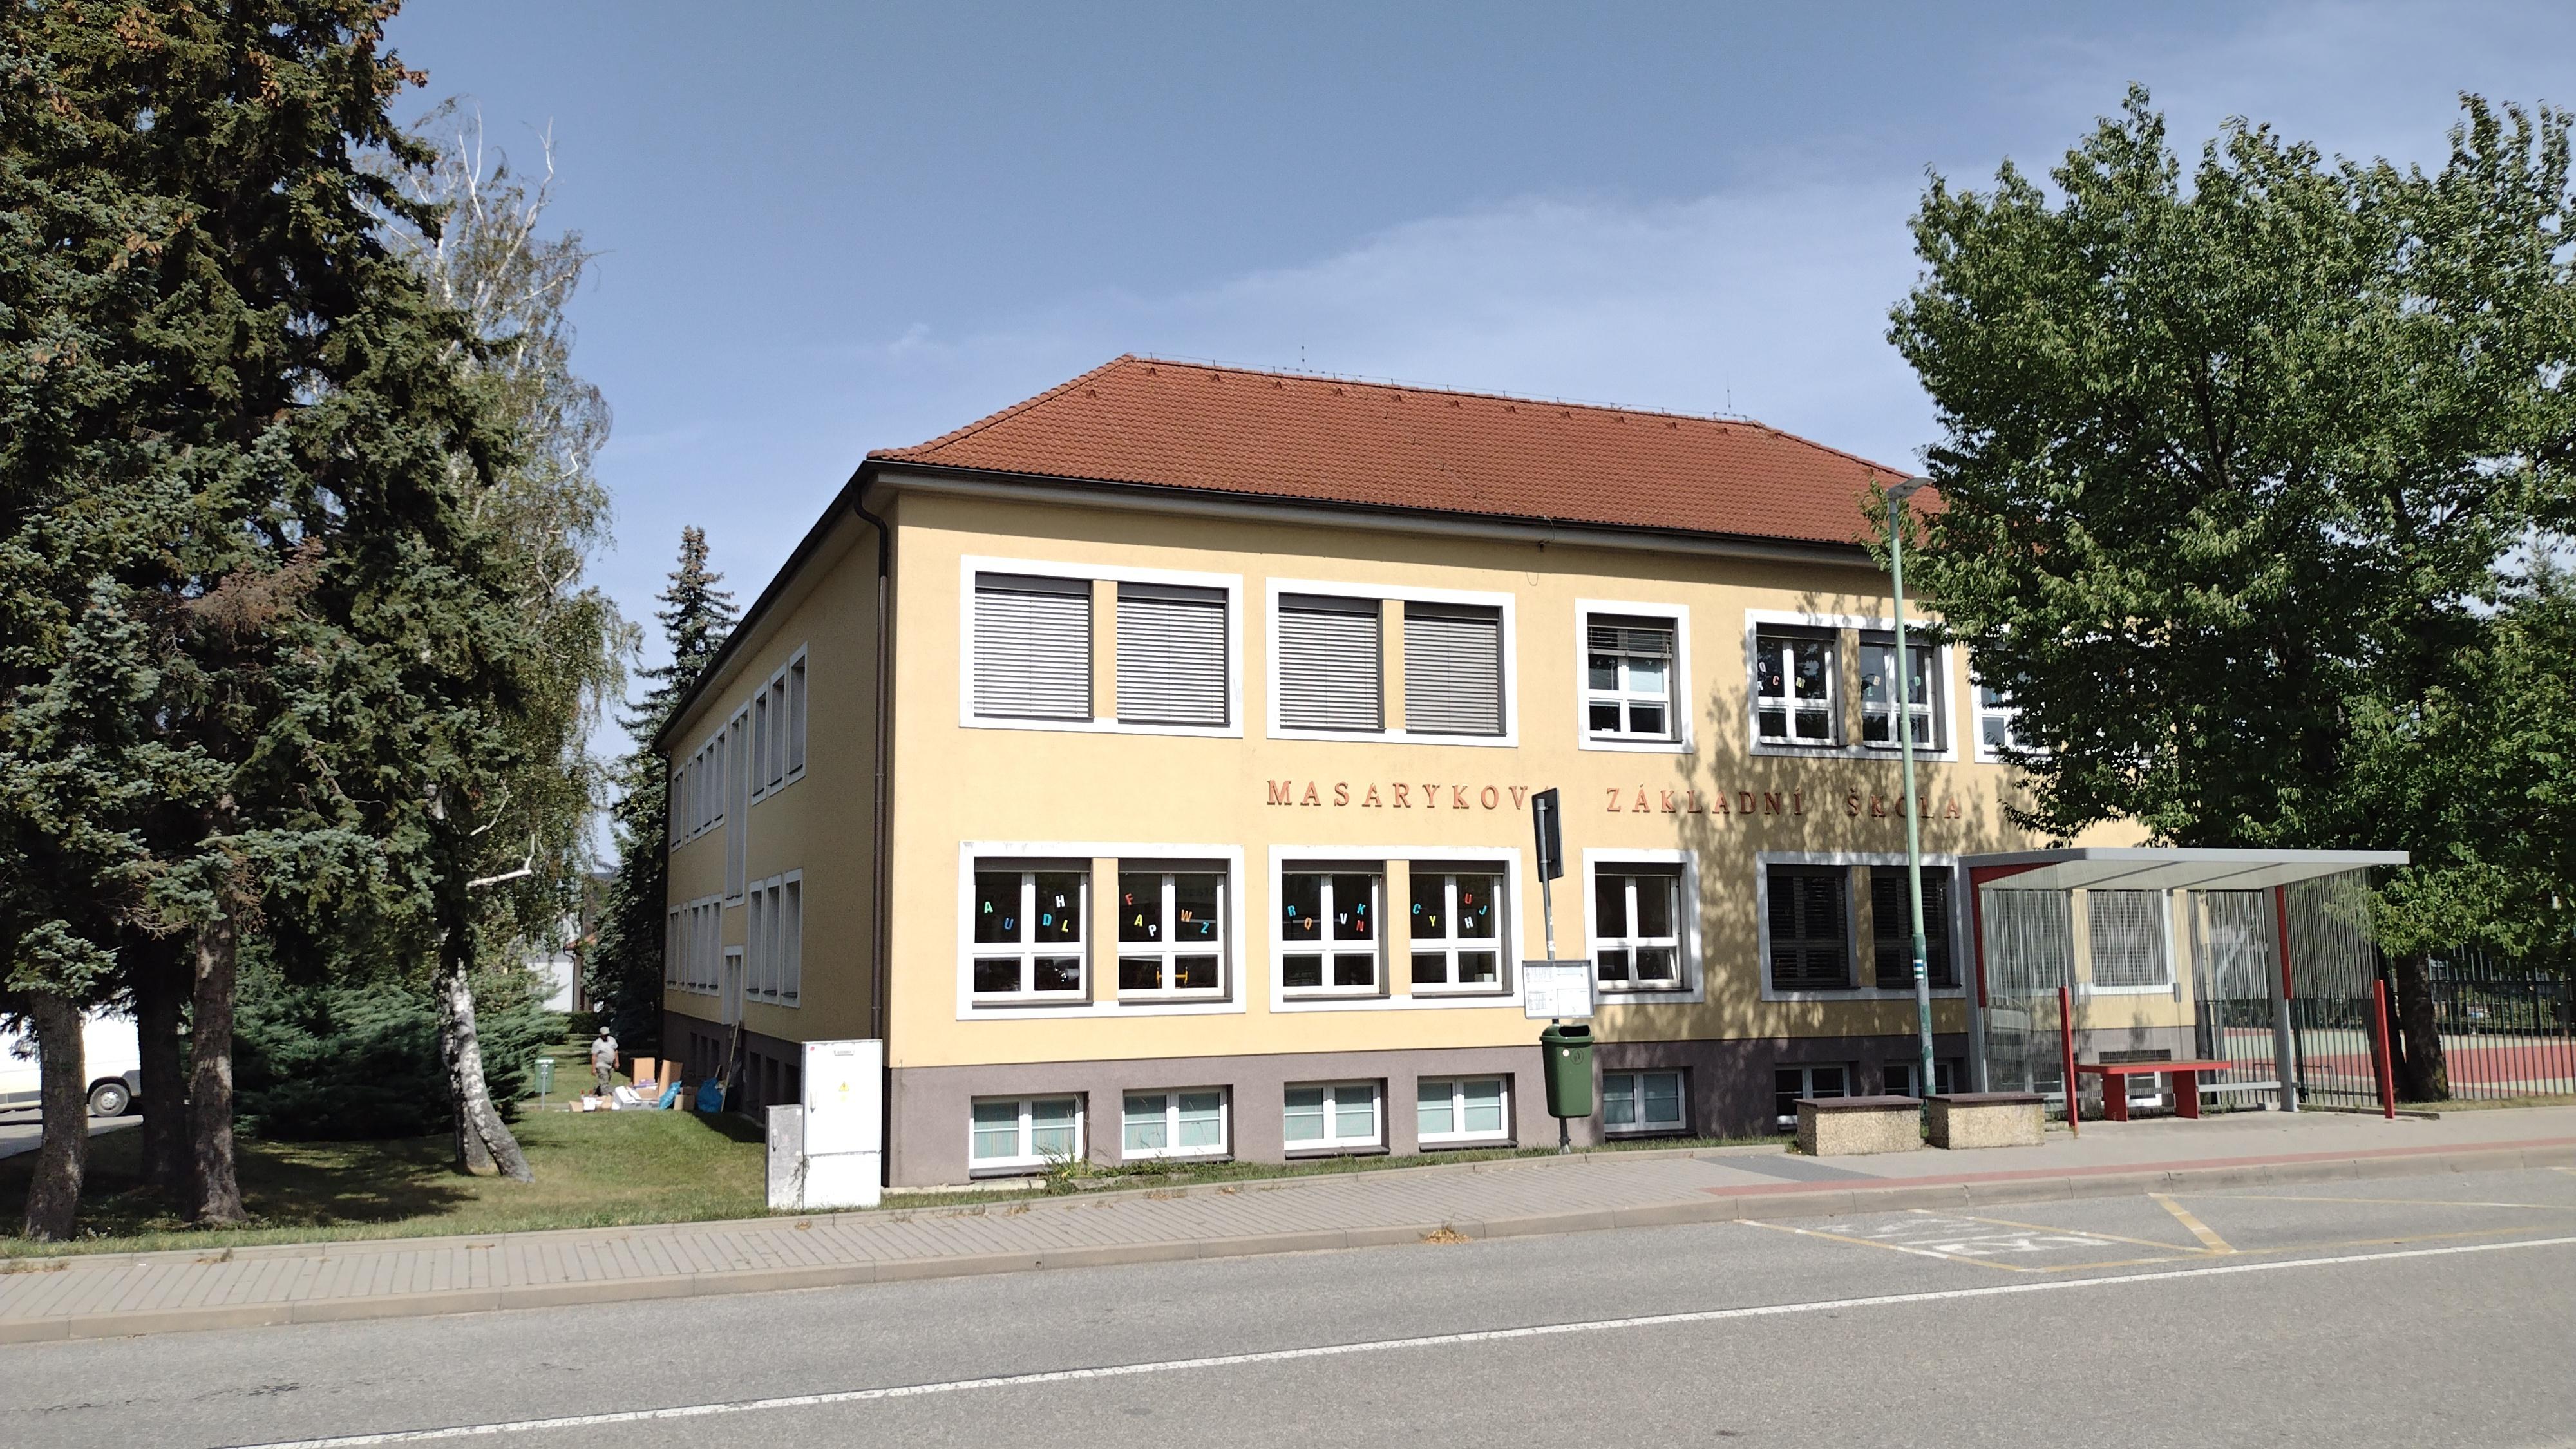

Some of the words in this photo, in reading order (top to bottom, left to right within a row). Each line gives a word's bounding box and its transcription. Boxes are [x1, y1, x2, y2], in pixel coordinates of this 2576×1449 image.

[1772, 675, 1779, 686] C
[1913, 676, 1921, 687] D
[1267, 779, 1548, 810] MASARYKOV
[1606, 784, 1803, 815] ZÁKLADNÍ
[1055, 895, 1065, 907] H
[1125, 893, 1133, 905] F
[984, 901, 993, 913] A
[1287, 905, 1296, 917] R
[1357, 904, 1366, 916] K
[1412, 903, 1421, 914] C
[1479, 905, 1487, 916] J
[1043, 914, 1052, 927] D
[1134, 914, 1143, 927] A
[1180, 909, 1192, 922] W
[1428, 915, 1437, 927] Y
[1201, 922, 1210, 934] Z
[1356, 920, 1365, 932] N
[1464, 916, 1473, 929] H
[1148, 924, 1157, 936] P
